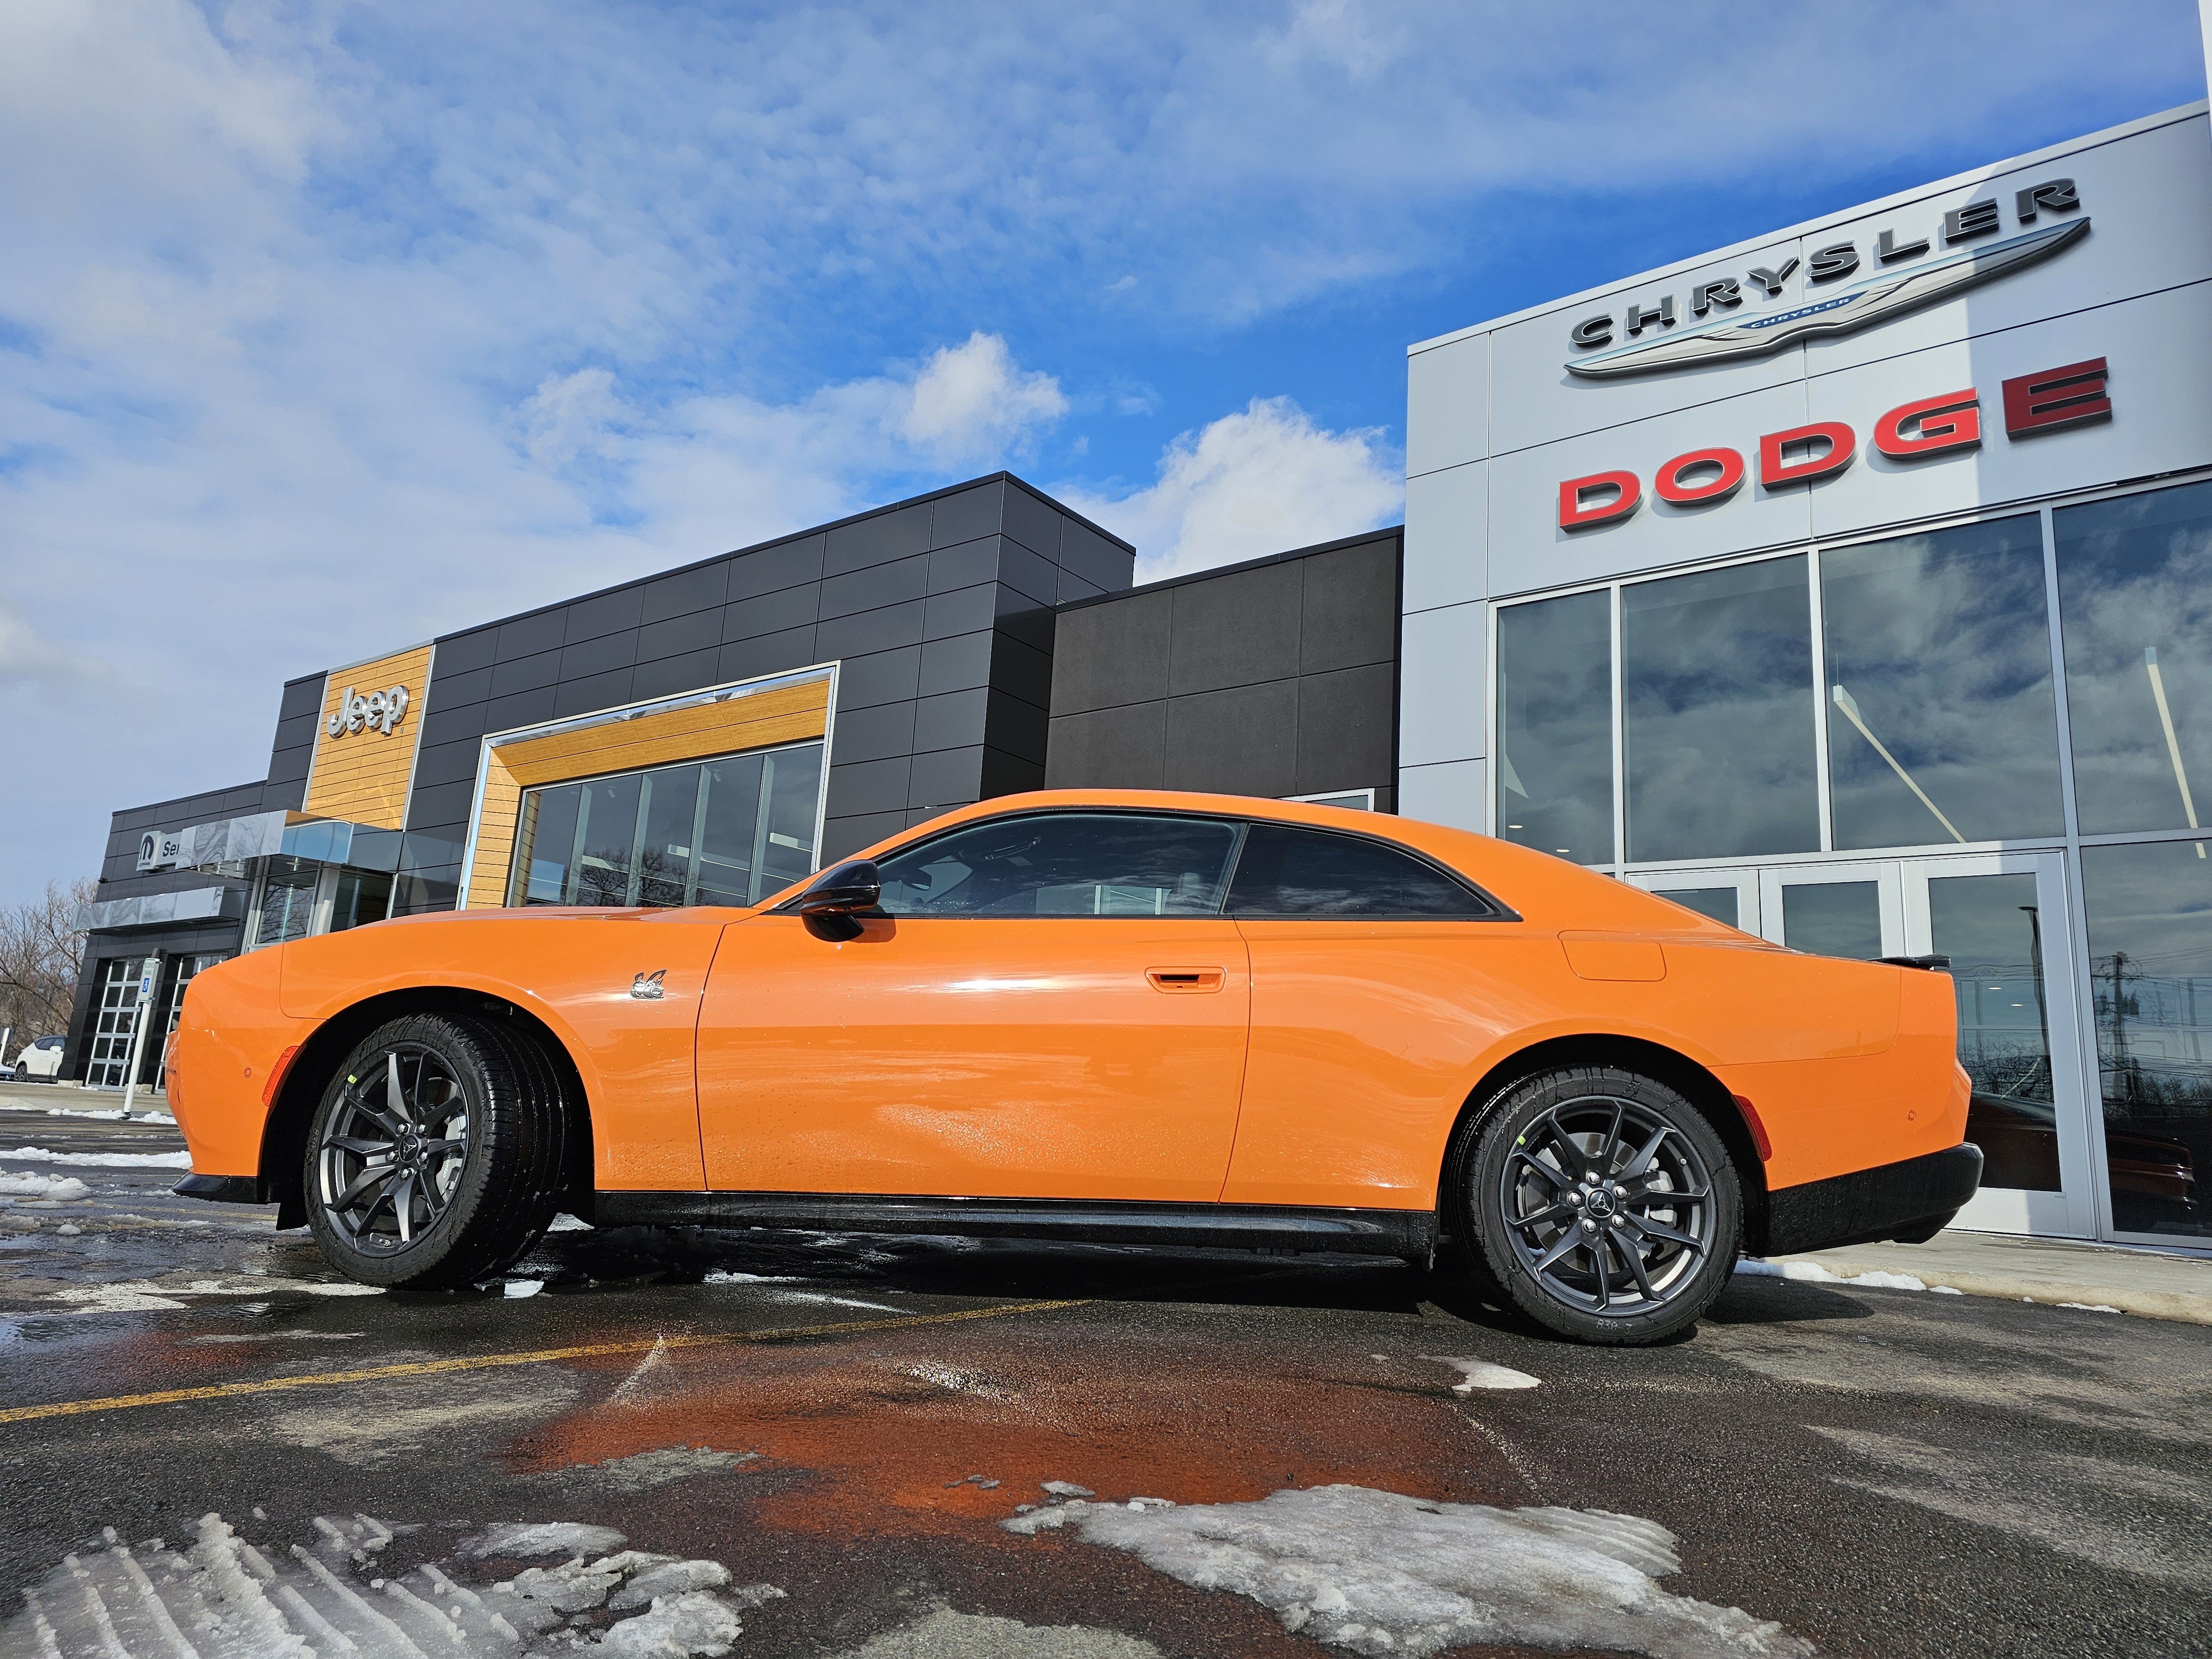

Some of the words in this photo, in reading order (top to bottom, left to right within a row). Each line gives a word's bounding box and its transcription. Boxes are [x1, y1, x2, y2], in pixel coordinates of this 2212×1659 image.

[1570, 178, 2080, 346] CHRYSLER
[1751, 298, 1849, 328] CHRYSLER
[1559, 356, 2112, 532] DODGE
[326, 685, 409, 738] Jeep
[442, 1152, 452, 1178] brembo
